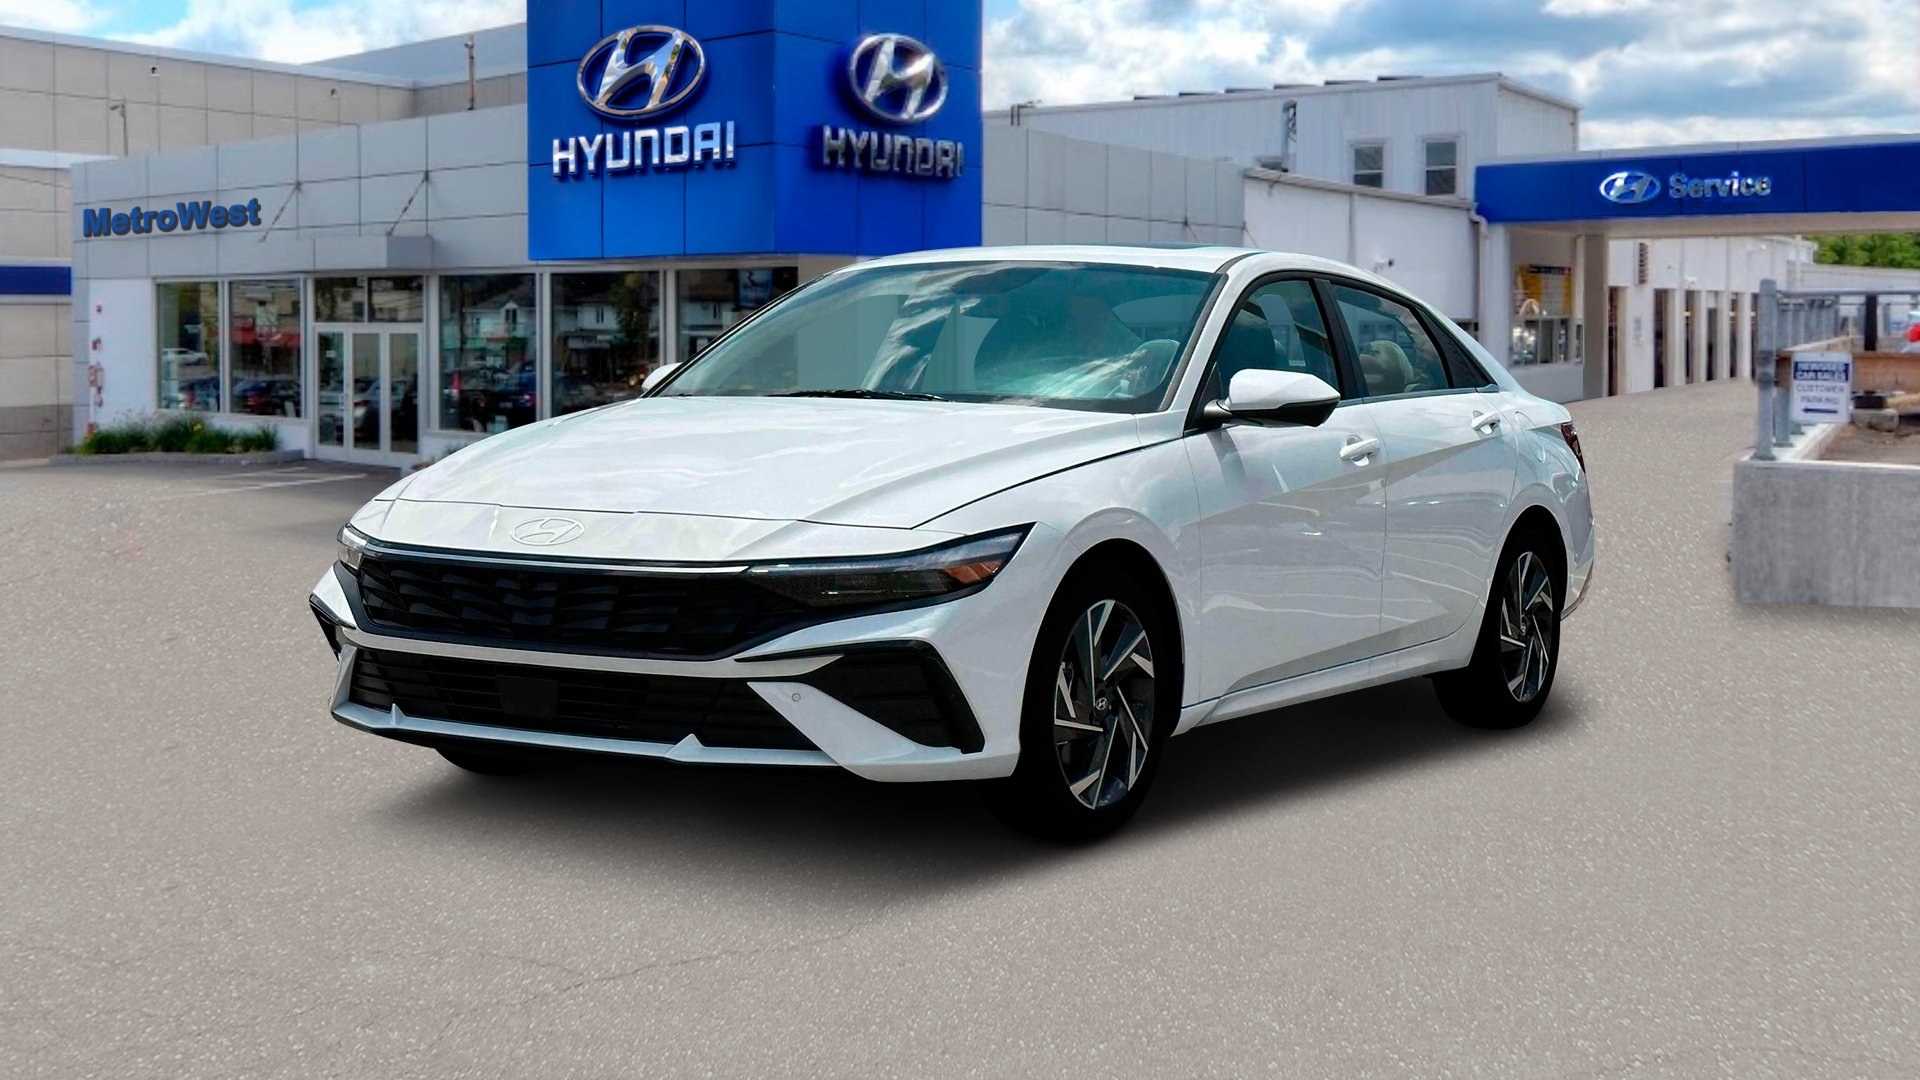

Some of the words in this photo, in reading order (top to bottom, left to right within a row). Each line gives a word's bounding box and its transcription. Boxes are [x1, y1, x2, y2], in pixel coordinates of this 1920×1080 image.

[551, 120, 736, 177] HYUNDAI
[822, 125, 964, 178] HYUNDAI
[1668, 171, 1772, 199] Service
[83, 198, 262, 238] MetroWest
